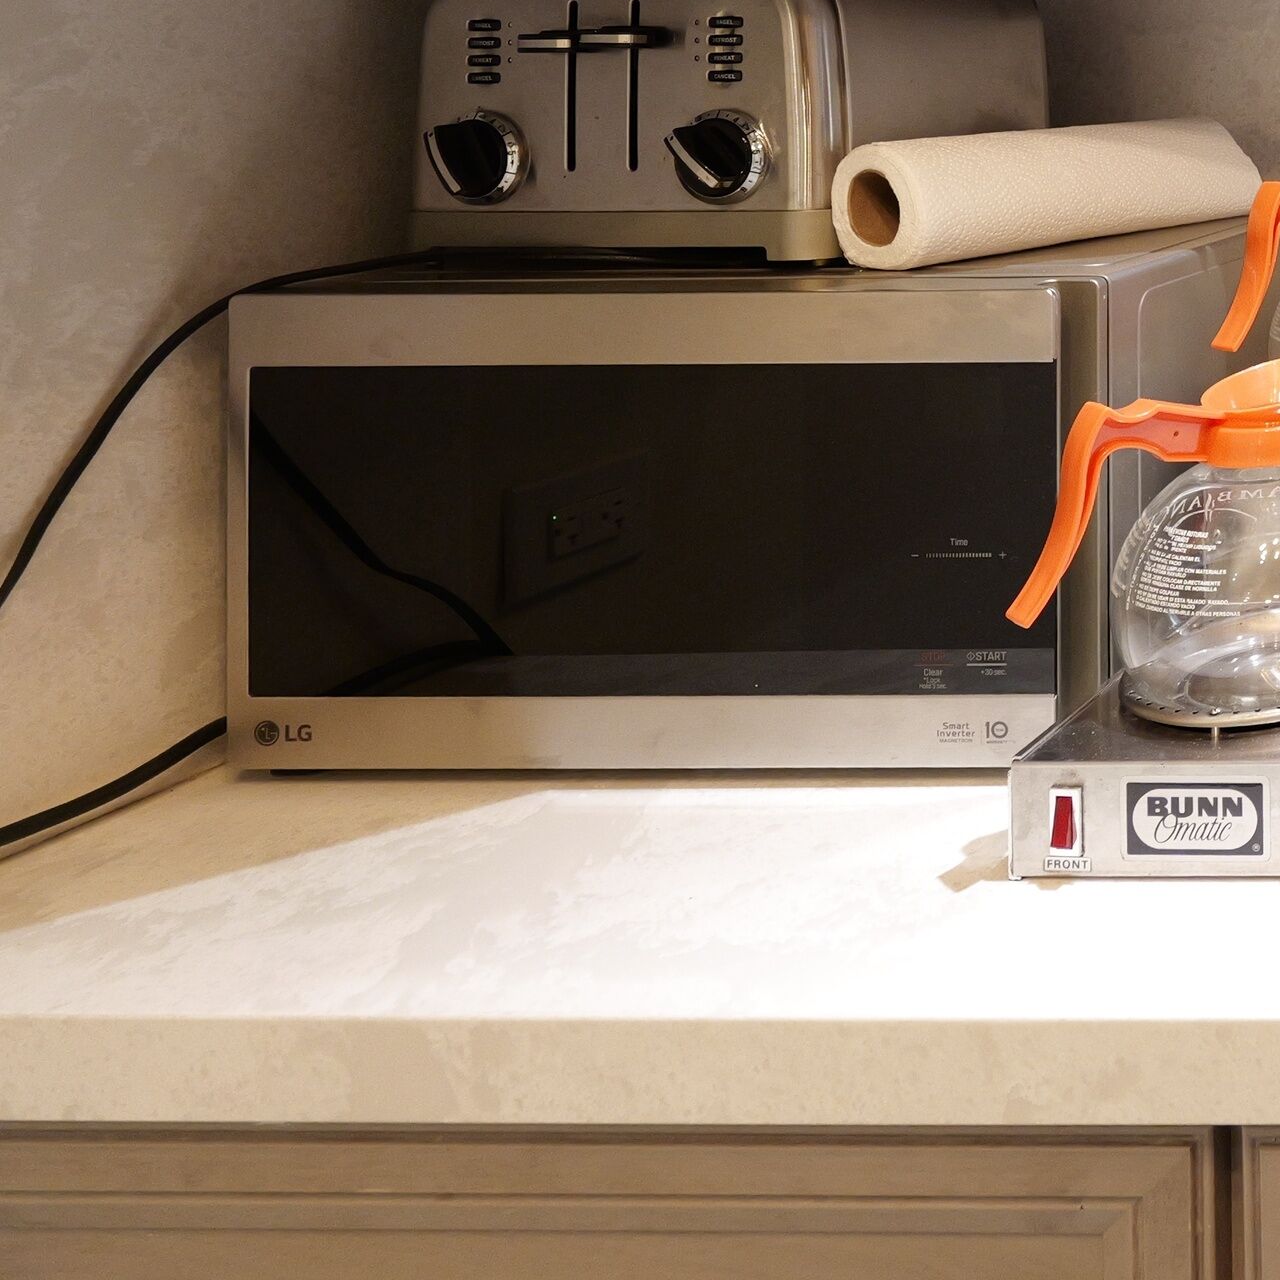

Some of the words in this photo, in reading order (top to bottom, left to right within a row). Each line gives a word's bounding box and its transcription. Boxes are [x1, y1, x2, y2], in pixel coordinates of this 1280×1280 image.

[950, 538, 969, 546] Time
[975, 651, 1007, 661] START
[923, 668, 943, 676] Clear
[284, 724, 313, 742] LG
[942, 722, 970, 730] Smart
[984, 721, 1008, 738] 10
[1146, 796, 1243, 818] BUNN
[1154, 813, 1233, 843] Omatic
[1047, 859, 1088, 869] FRONT
